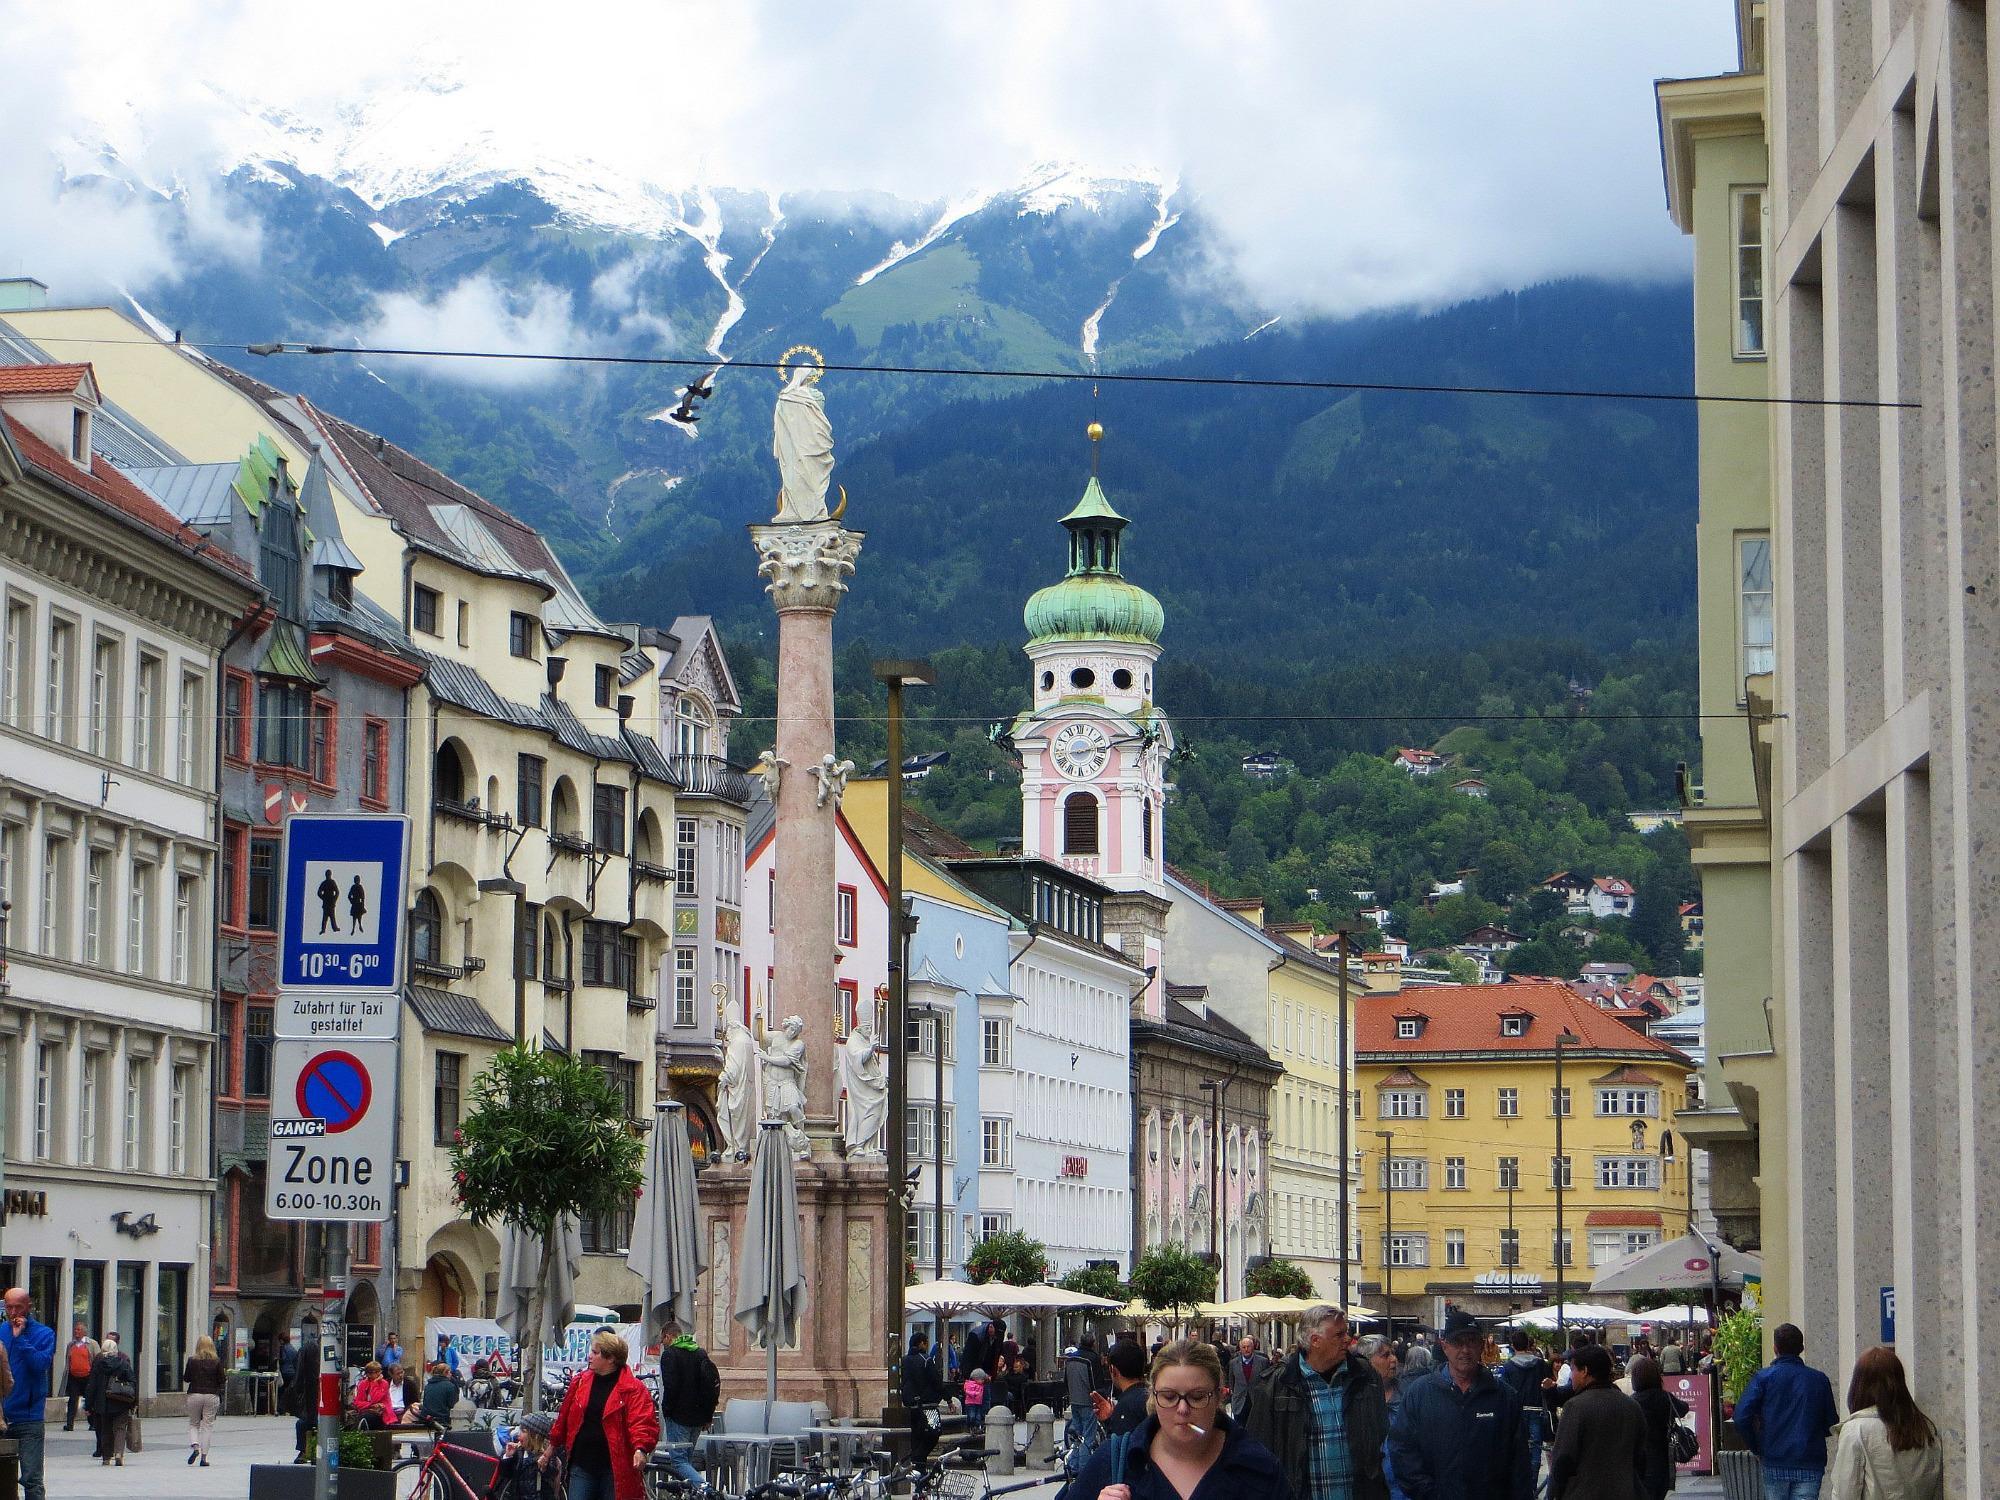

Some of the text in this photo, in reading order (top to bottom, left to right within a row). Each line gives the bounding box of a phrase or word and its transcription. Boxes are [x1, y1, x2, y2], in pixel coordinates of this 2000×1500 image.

[293, 1000, 383, 1015] Zufahrt für Taxi
[311, 1018, 363, 1034] gestattet
[273, 1121, 325, 1136] GANG+
[284, 1144, 373, 1185] Zone
[276, 1193, 381, 1211] 6.00-10.30h
